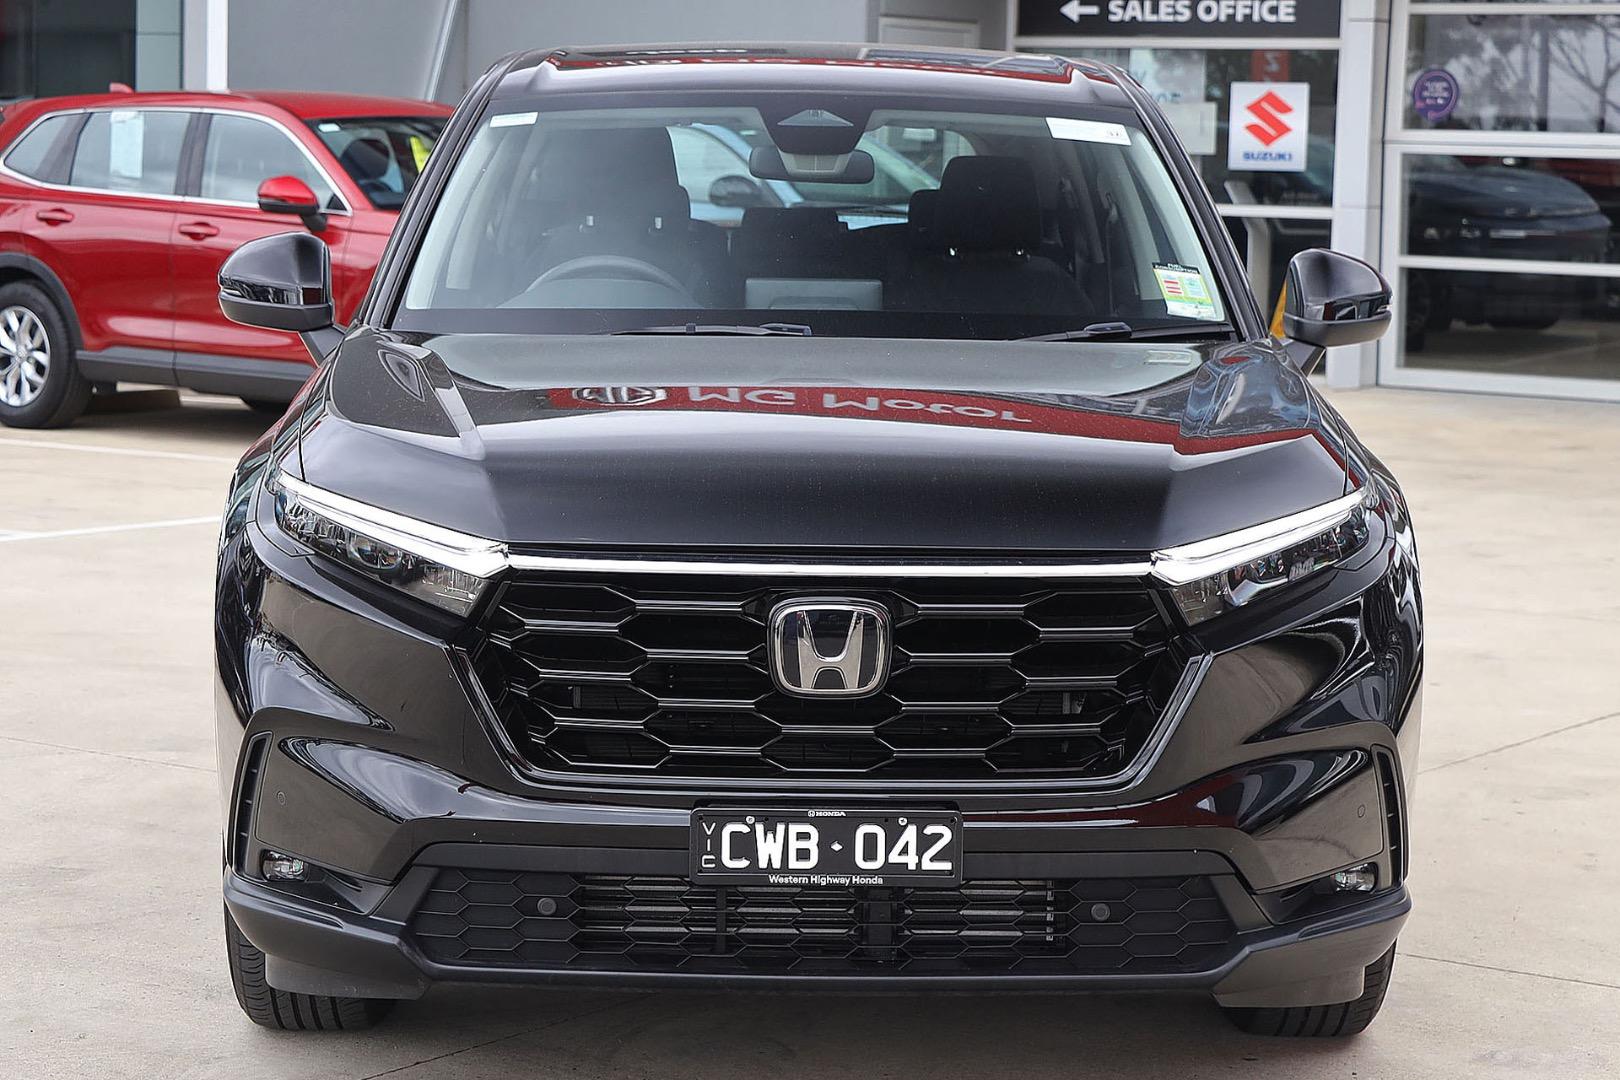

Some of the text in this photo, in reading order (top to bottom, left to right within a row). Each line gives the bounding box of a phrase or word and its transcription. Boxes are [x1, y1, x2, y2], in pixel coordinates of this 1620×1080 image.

[1108, 0, 1297, 22] SALES OFFICE
[1242, 151, 1292, 161] SUZUKI
[701, 822, 717, 868] VIC
[721, 822, 953, 871] CWB 042
[769, 874, 884, 886] Western Highway Honda
